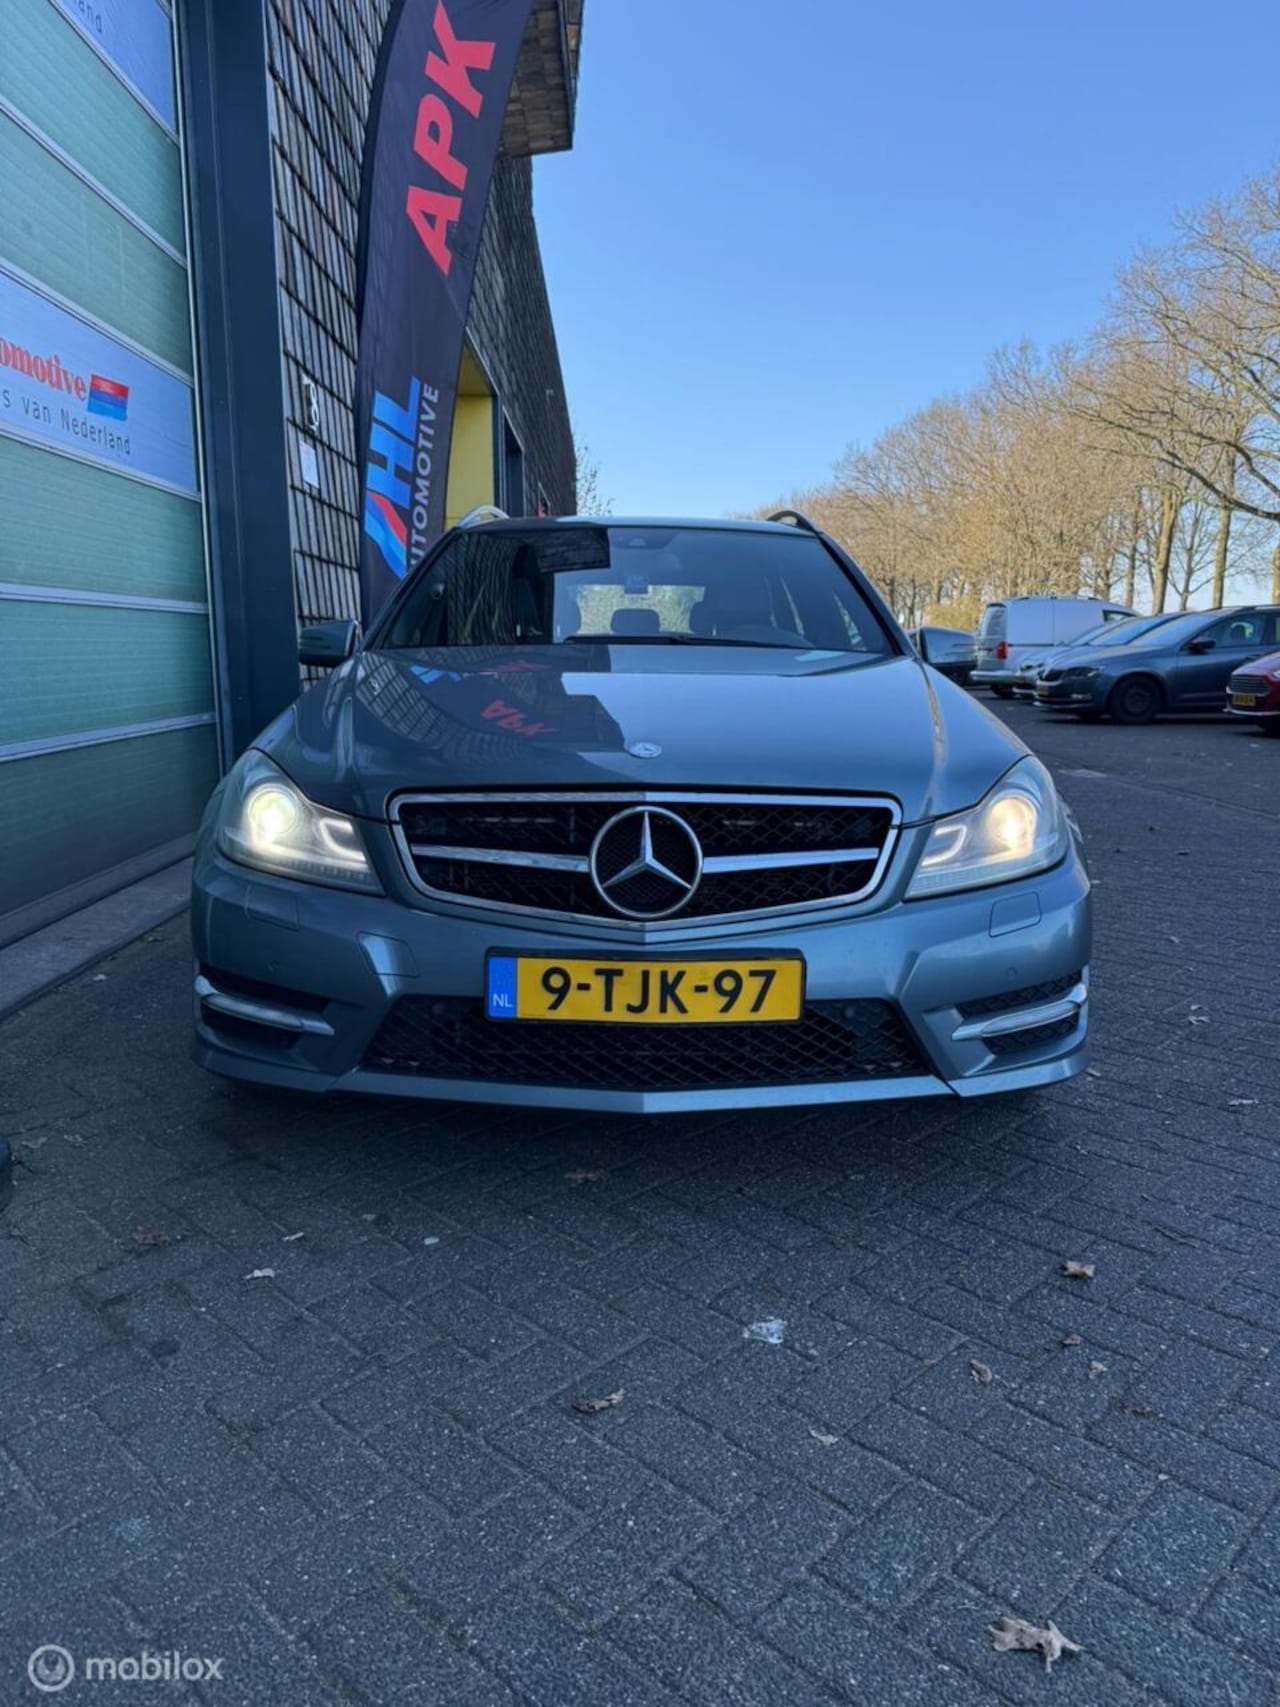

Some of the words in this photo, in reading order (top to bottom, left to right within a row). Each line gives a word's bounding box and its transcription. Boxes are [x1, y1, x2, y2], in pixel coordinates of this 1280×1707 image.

[406, 0, 496, 276] APK
[22, 396, 51, 424] van
[60, 407, 131, 455] Nederland
[492, 993, 513, 1007] NL
[541, 967, 777, 1014] 9-TJK-97
